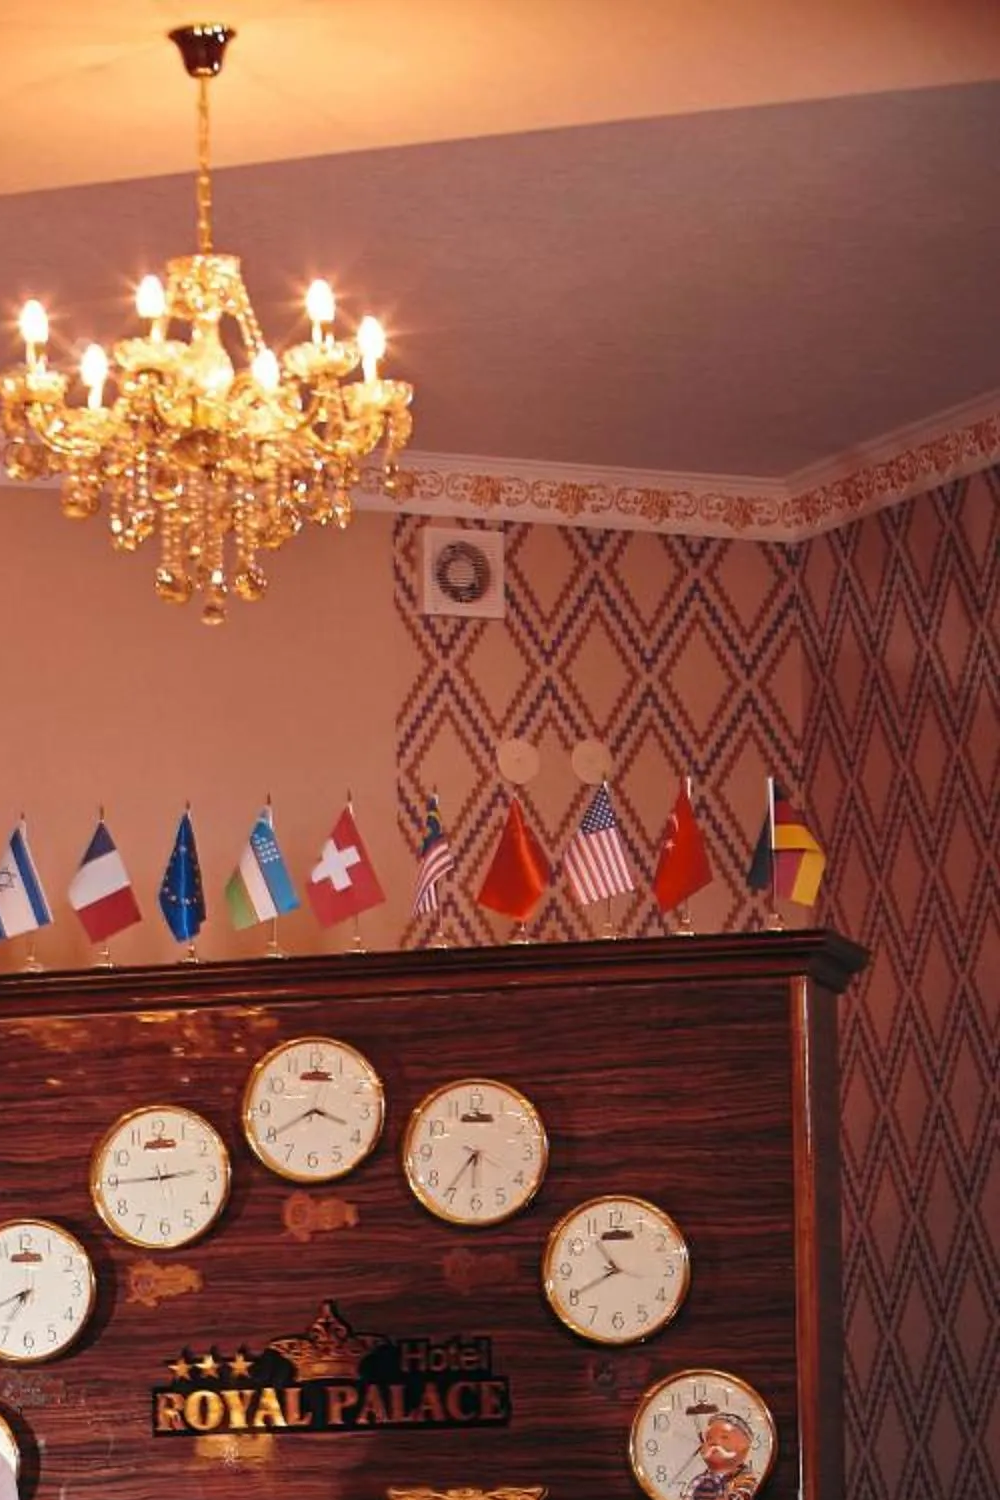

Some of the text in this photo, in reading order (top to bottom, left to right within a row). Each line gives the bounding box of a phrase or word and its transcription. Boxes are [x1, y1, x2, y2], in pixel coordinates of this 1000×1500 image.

[288, 1056, 298, 1073] 11
[309, 1052, 323, 1071] 12
[268, 1077, 285, 1094] 10
[259, 1100, 270, 1117] 9
[360, 1103, 370, 1120] 3
[448, 1101, 459, 1118] 11
[470, 1093, 484, 1113] 12
[151, 1120, 165, 1138] 12
[266, 1127, 277, 1143] 8
[349, 1129, 361, 1143] 4
[429, 1120, 445, 1136] 10
[131, 1128, 141, 1146] 11
[198, 1140, 208, 1157] 2
[284, 1143, 295, 1162] 7
[332, 1145, 343, 1163] 5
[523, 1143, 533, 1161] 3
[114, 1150, 130, 1167] 10
[307, 1151, 319, 1168] 6
[107, 1174, 118, 1190] 9
[207, 1165, 217, 1182] 3
[429, 1169, 439, 1187] 8
[513, 1170, 524, 1185] 4
[200, 1190, 210, 1206] 4
[448, 1187, 457, 1204] 7
[470, 1193, 483, 1211] 6
[495, 1187, 506, 1205] 5
[117, 1200, 128, 1216] 8
[136, 1213, 146, 1232] 7
[159, 1217, 171, 1236] 6
[183, 1209, 193, 1227] 5
[587, 1218, 597, 1235] 11
[609, 1210, 624, 1228] 12
[19, 1233, 33, 1252] 12
[568, 1238, 584, 1256] 10
[656, 1234, 667, 1251] 2
[63, 1254, 73, 1272] 2
[560, 1262, 572, 1280] 9
[664, 1260, 675, 1277] 3
[72, 1280, 81, 1297] 3
[655, 1287, 666, 1301] 4
[569, 1289, 579, 1306] 8
[64, 1306, 74, 1321] 4
[588, 1305, 598, 1325] 7
[612, 1312, 625, 1329] 6
[637, 1304, 648, 1322] 5
[1, 1326, 10, 1343] 7
[23, 1332, 35, 1348] 6
[48, 1324, 57, 1342] 5
[401, 1341, 491, 1373] Hotel
[693, 1384, 708, 1402] 12
[155, 1380, 506, 1431] ROYAL PALACE
[671, 1394, 680, 1410] 11
[653, 1413, 670, 1432] 10
[645, 1440, 658, 1456] 9
[656, 1465, 666, 1482] 8
